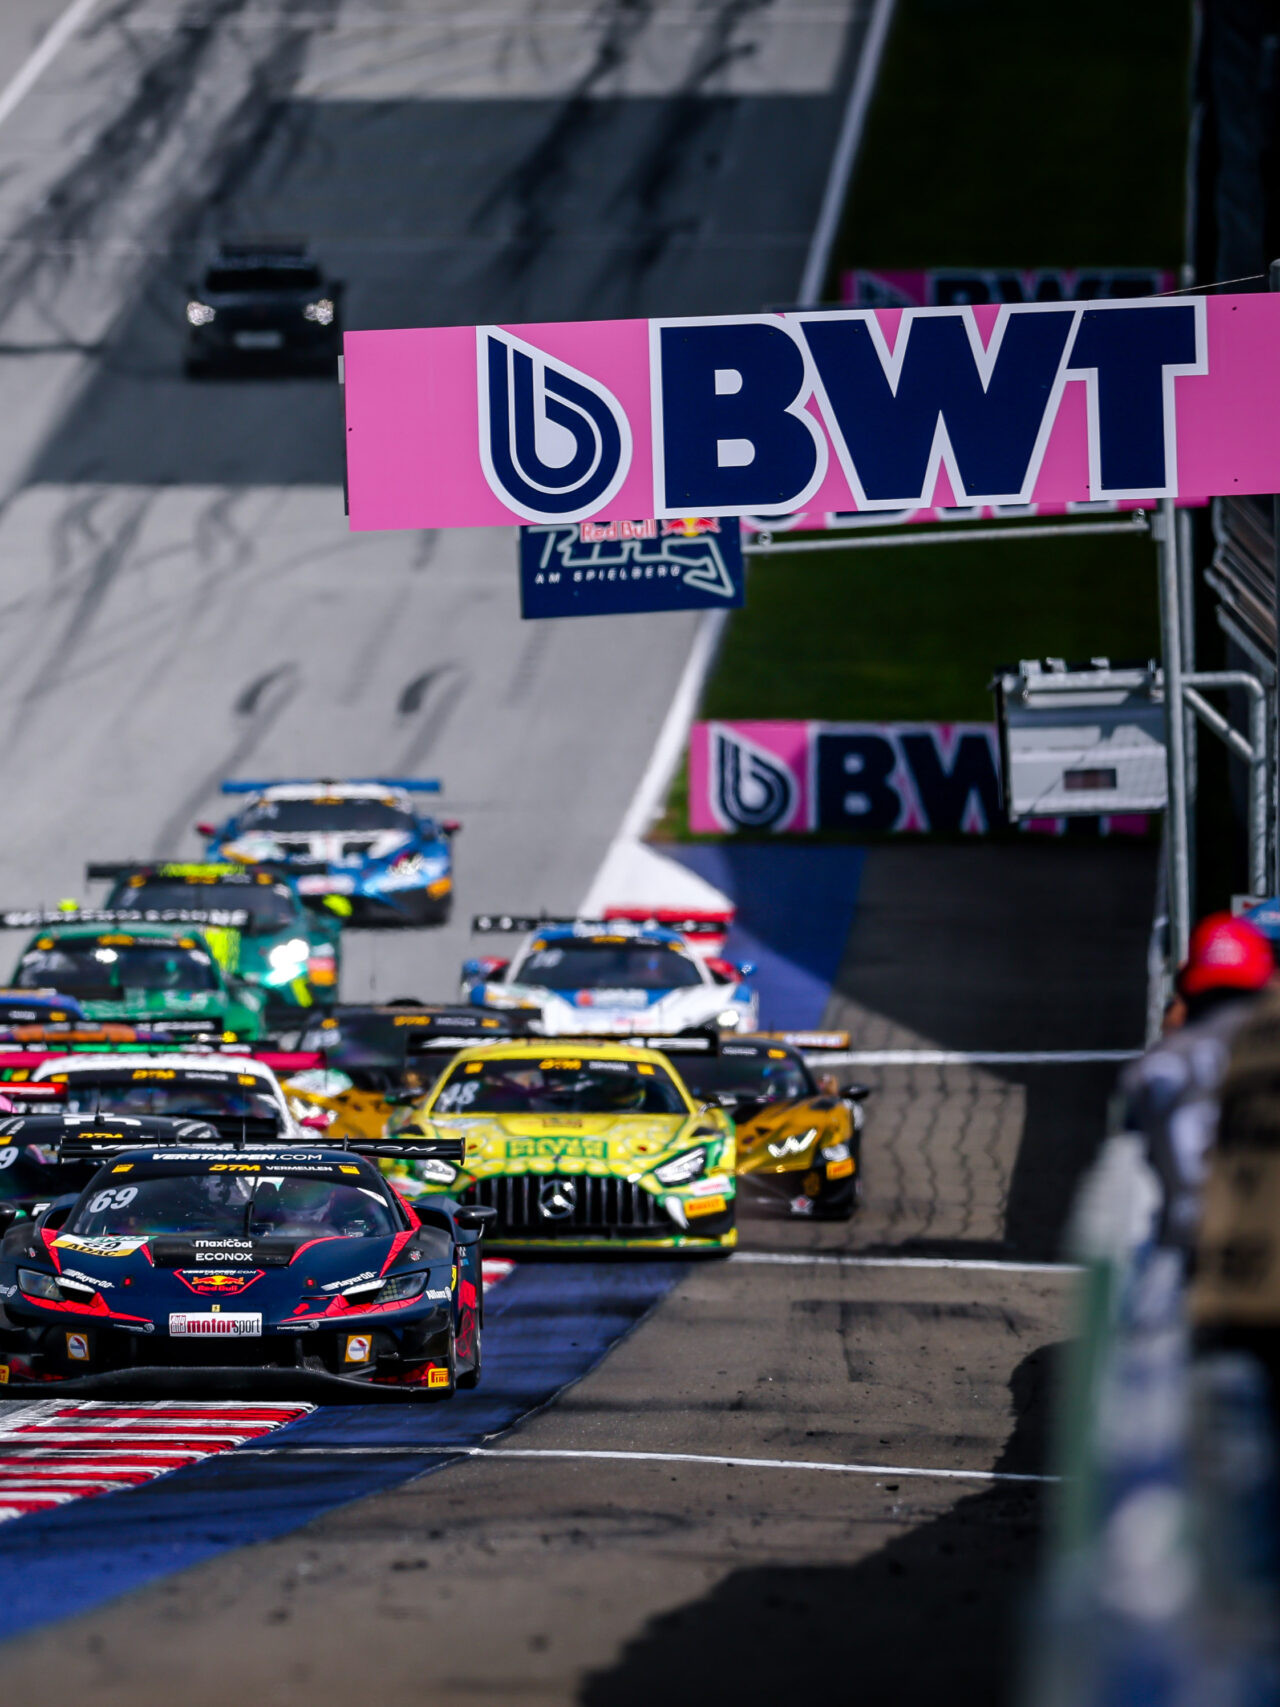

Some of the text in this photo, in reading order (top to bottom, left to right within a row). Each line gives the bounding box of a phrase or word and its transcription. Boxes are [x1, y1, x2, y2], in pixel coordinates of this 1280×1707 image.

[650, 296, 1208, 519] BWT
[581, 518, 657, 543] Red Bull
[535, 564, 681, 584] AM SPIELBERG
[809, 721, 1008, 834] BW
[152, 1153, 323, 1162] VERSTAPPEN.COM
[209, 1164, 262, 1172] DTM
[89, 1186, 139, 1214] 69
[195, 1238, 253, 1248] MaxiCool
[195, 1252, 253, 1262] ECONOX
[187, 1318, 260, 1336] motorsport
